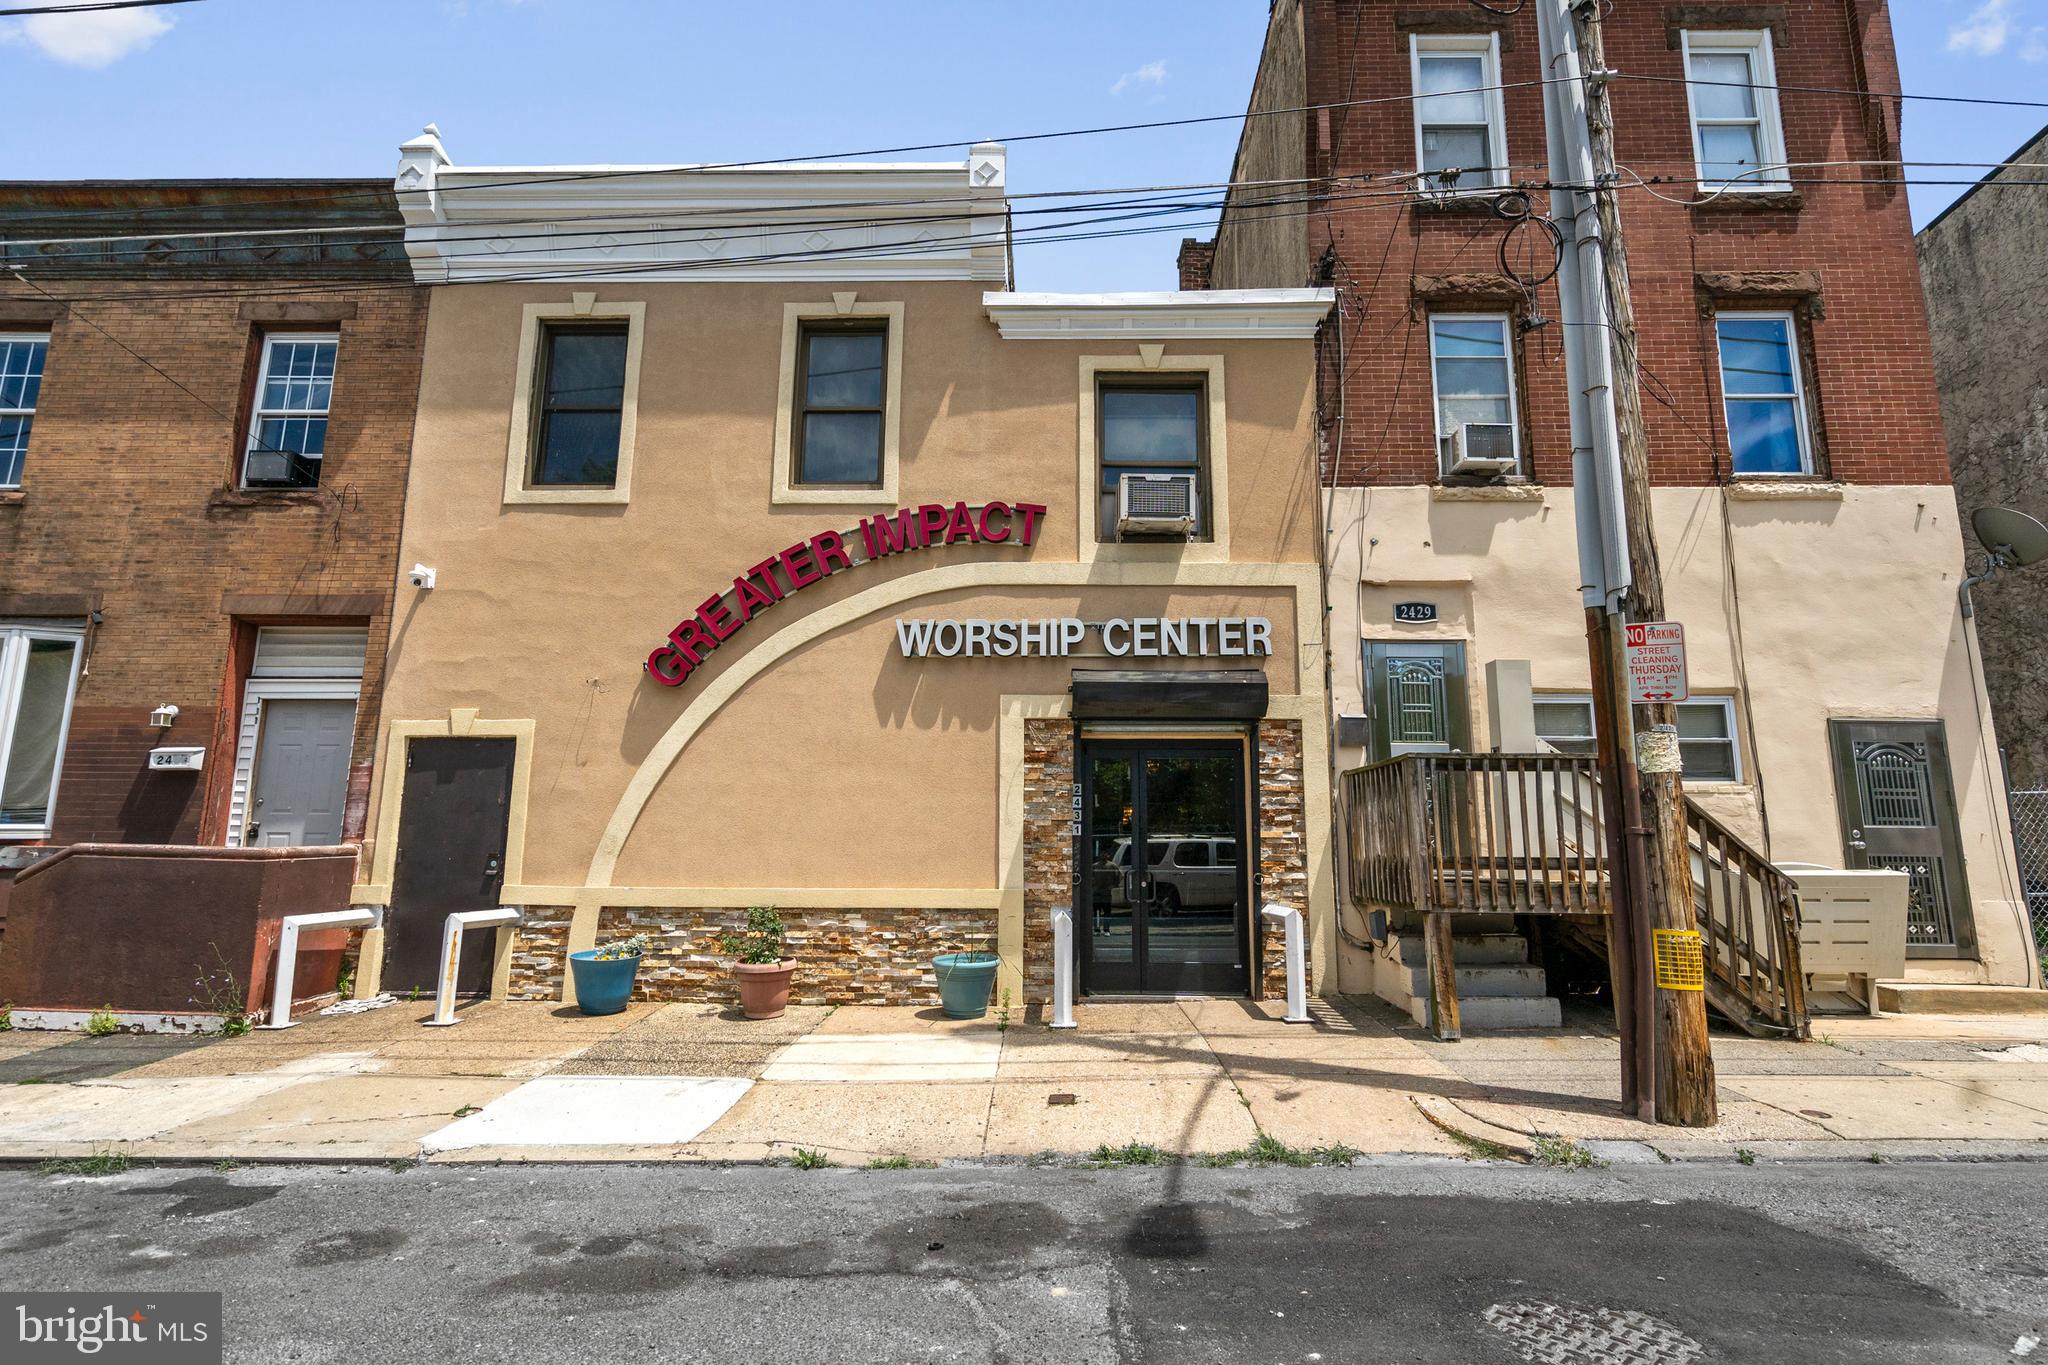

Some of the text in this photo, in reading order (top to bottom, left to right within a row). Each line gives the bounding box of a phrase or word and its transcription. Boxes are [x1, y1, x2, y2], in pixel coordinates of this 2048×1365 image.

[646, 501, 1047, 688] GREATER IMPACT
[1400, 606, 1431, 618] 2429
[896, 617, 1273, 658] WORSHIP CENTER
[1626, 628, 1680, 644] NO PARKING
[1637, 646, 1671, 656] STREET
[1631, 655, 1679, 665] CLEANING
[1629, 664, 1682, 675] THURSDAY
